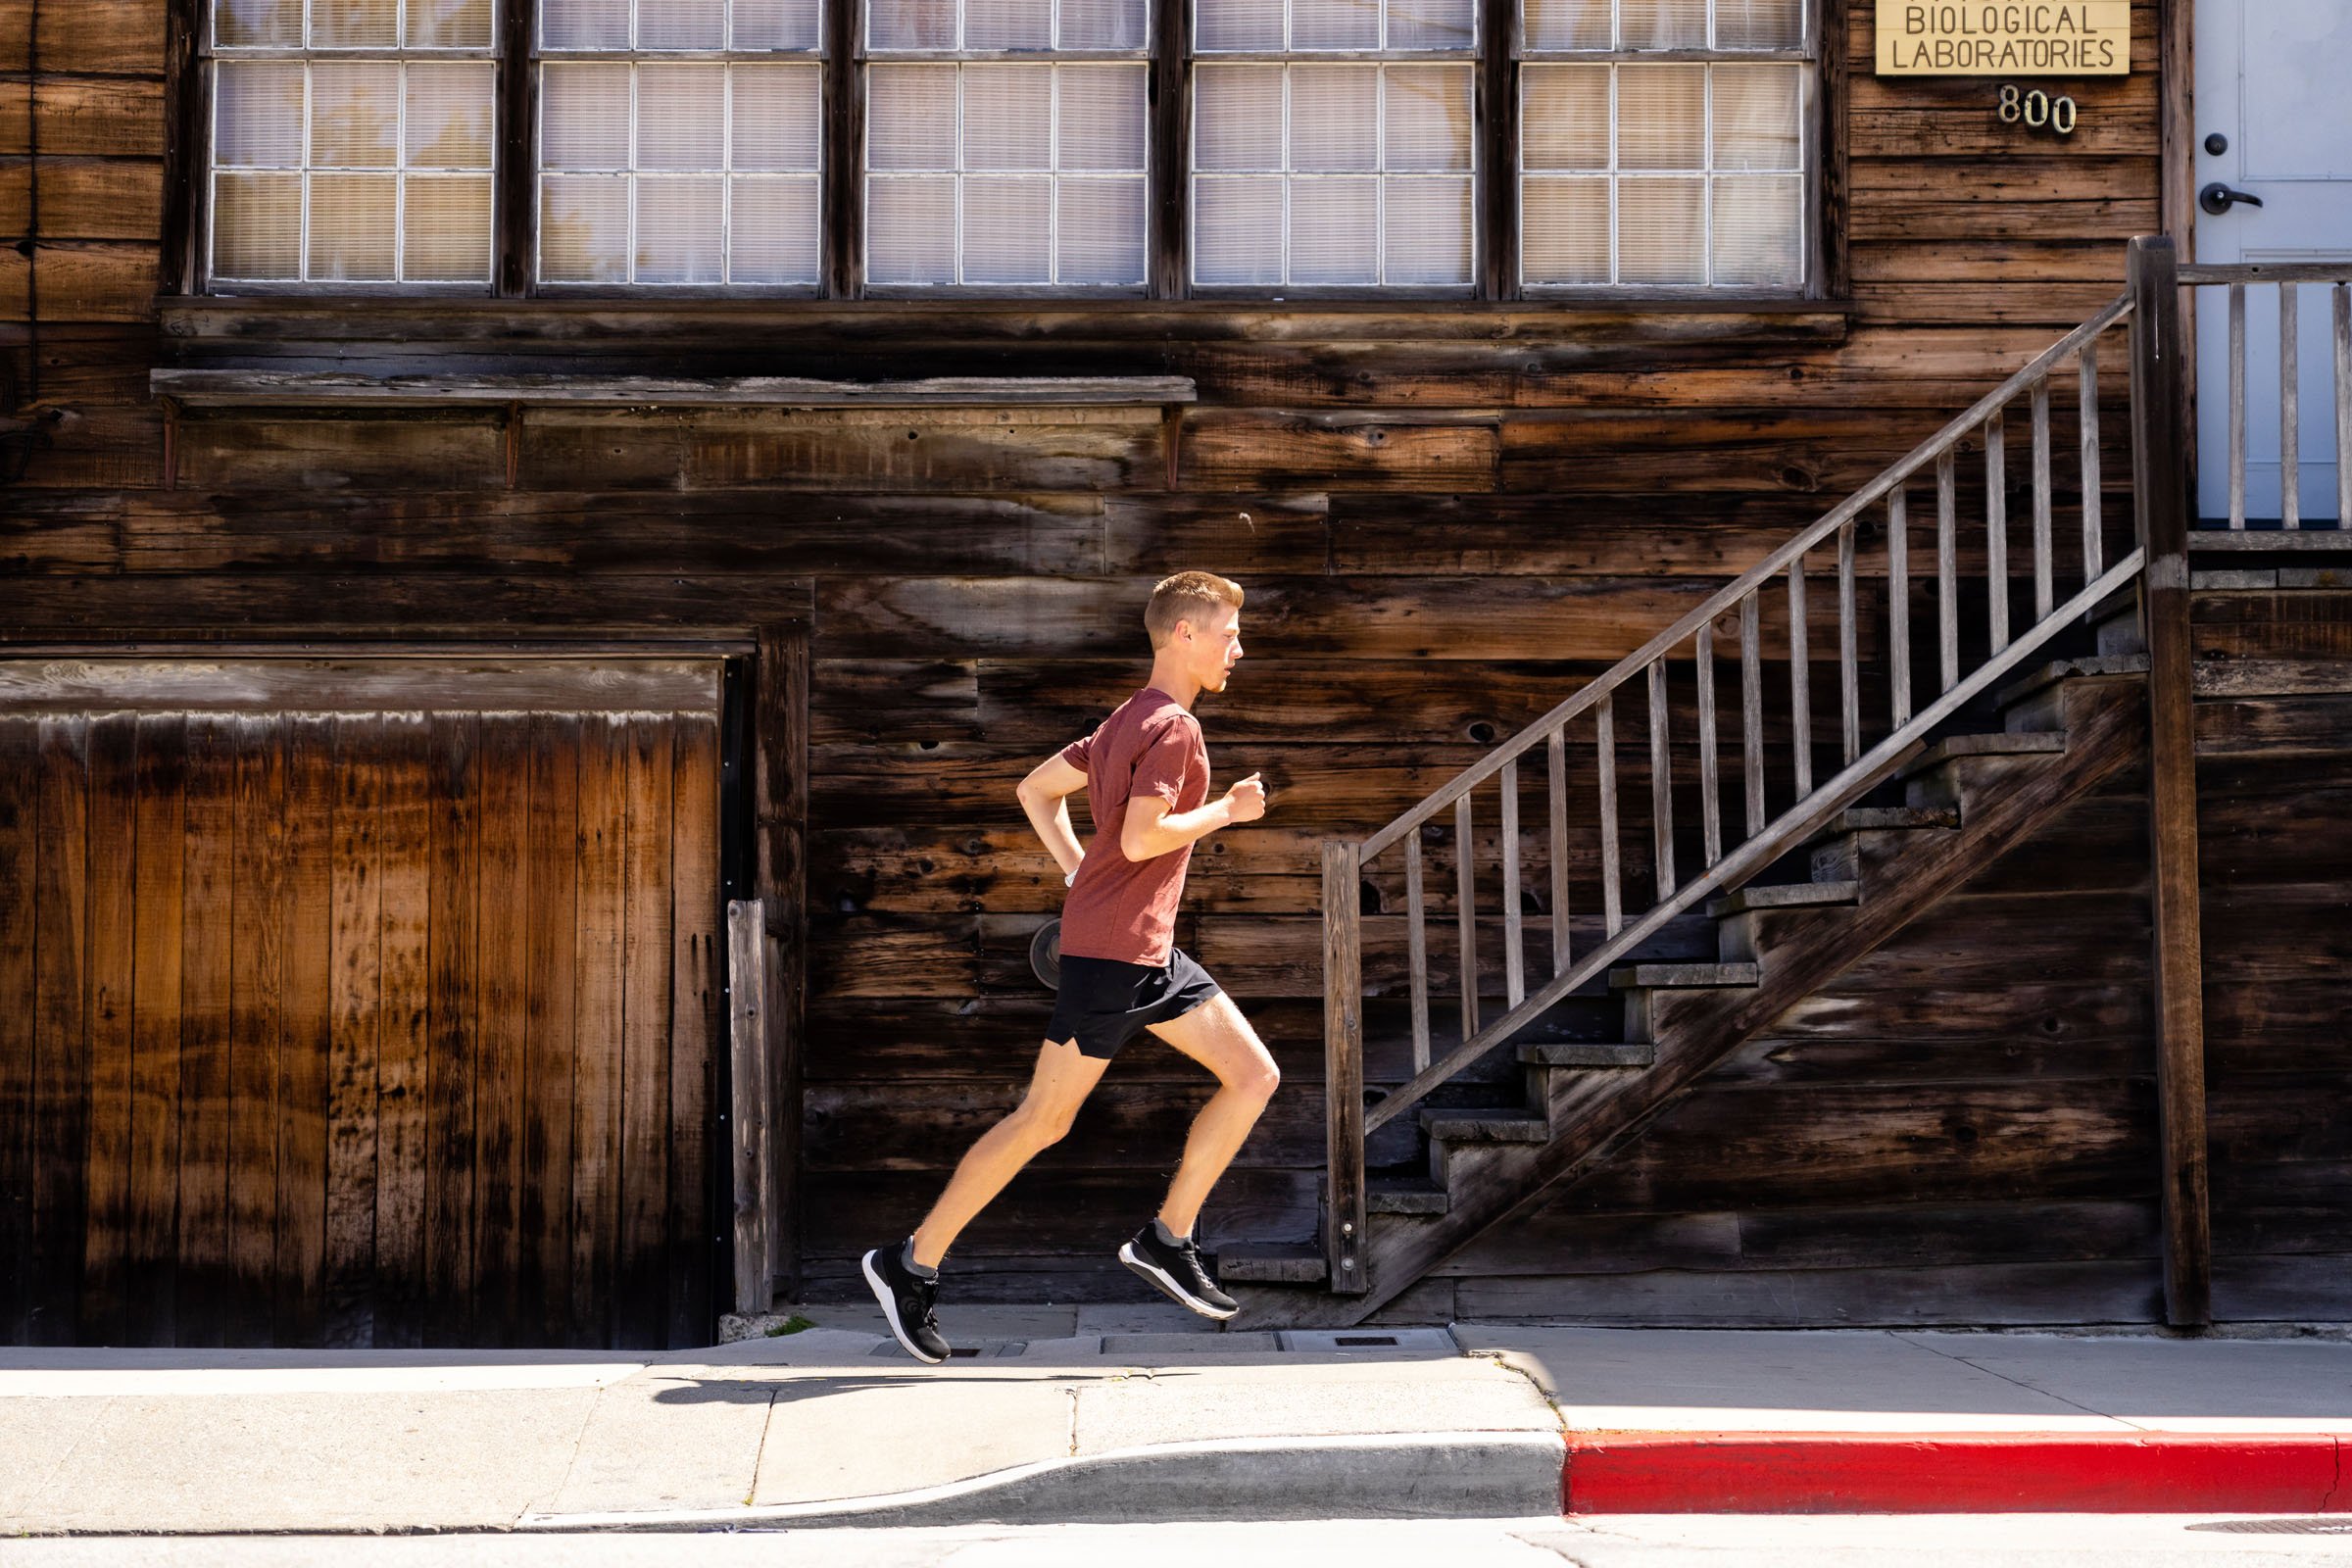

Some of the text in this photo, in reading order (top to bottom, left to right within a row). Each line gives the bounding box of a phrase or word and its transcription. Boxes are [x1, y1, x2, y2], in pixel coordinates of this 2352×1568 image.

[1906, 6, 2097, 34] BIOLOGICAL
[1892, 39, 2114, 69] LABORATORIES
[1998, 84, 2077, 134] 800
